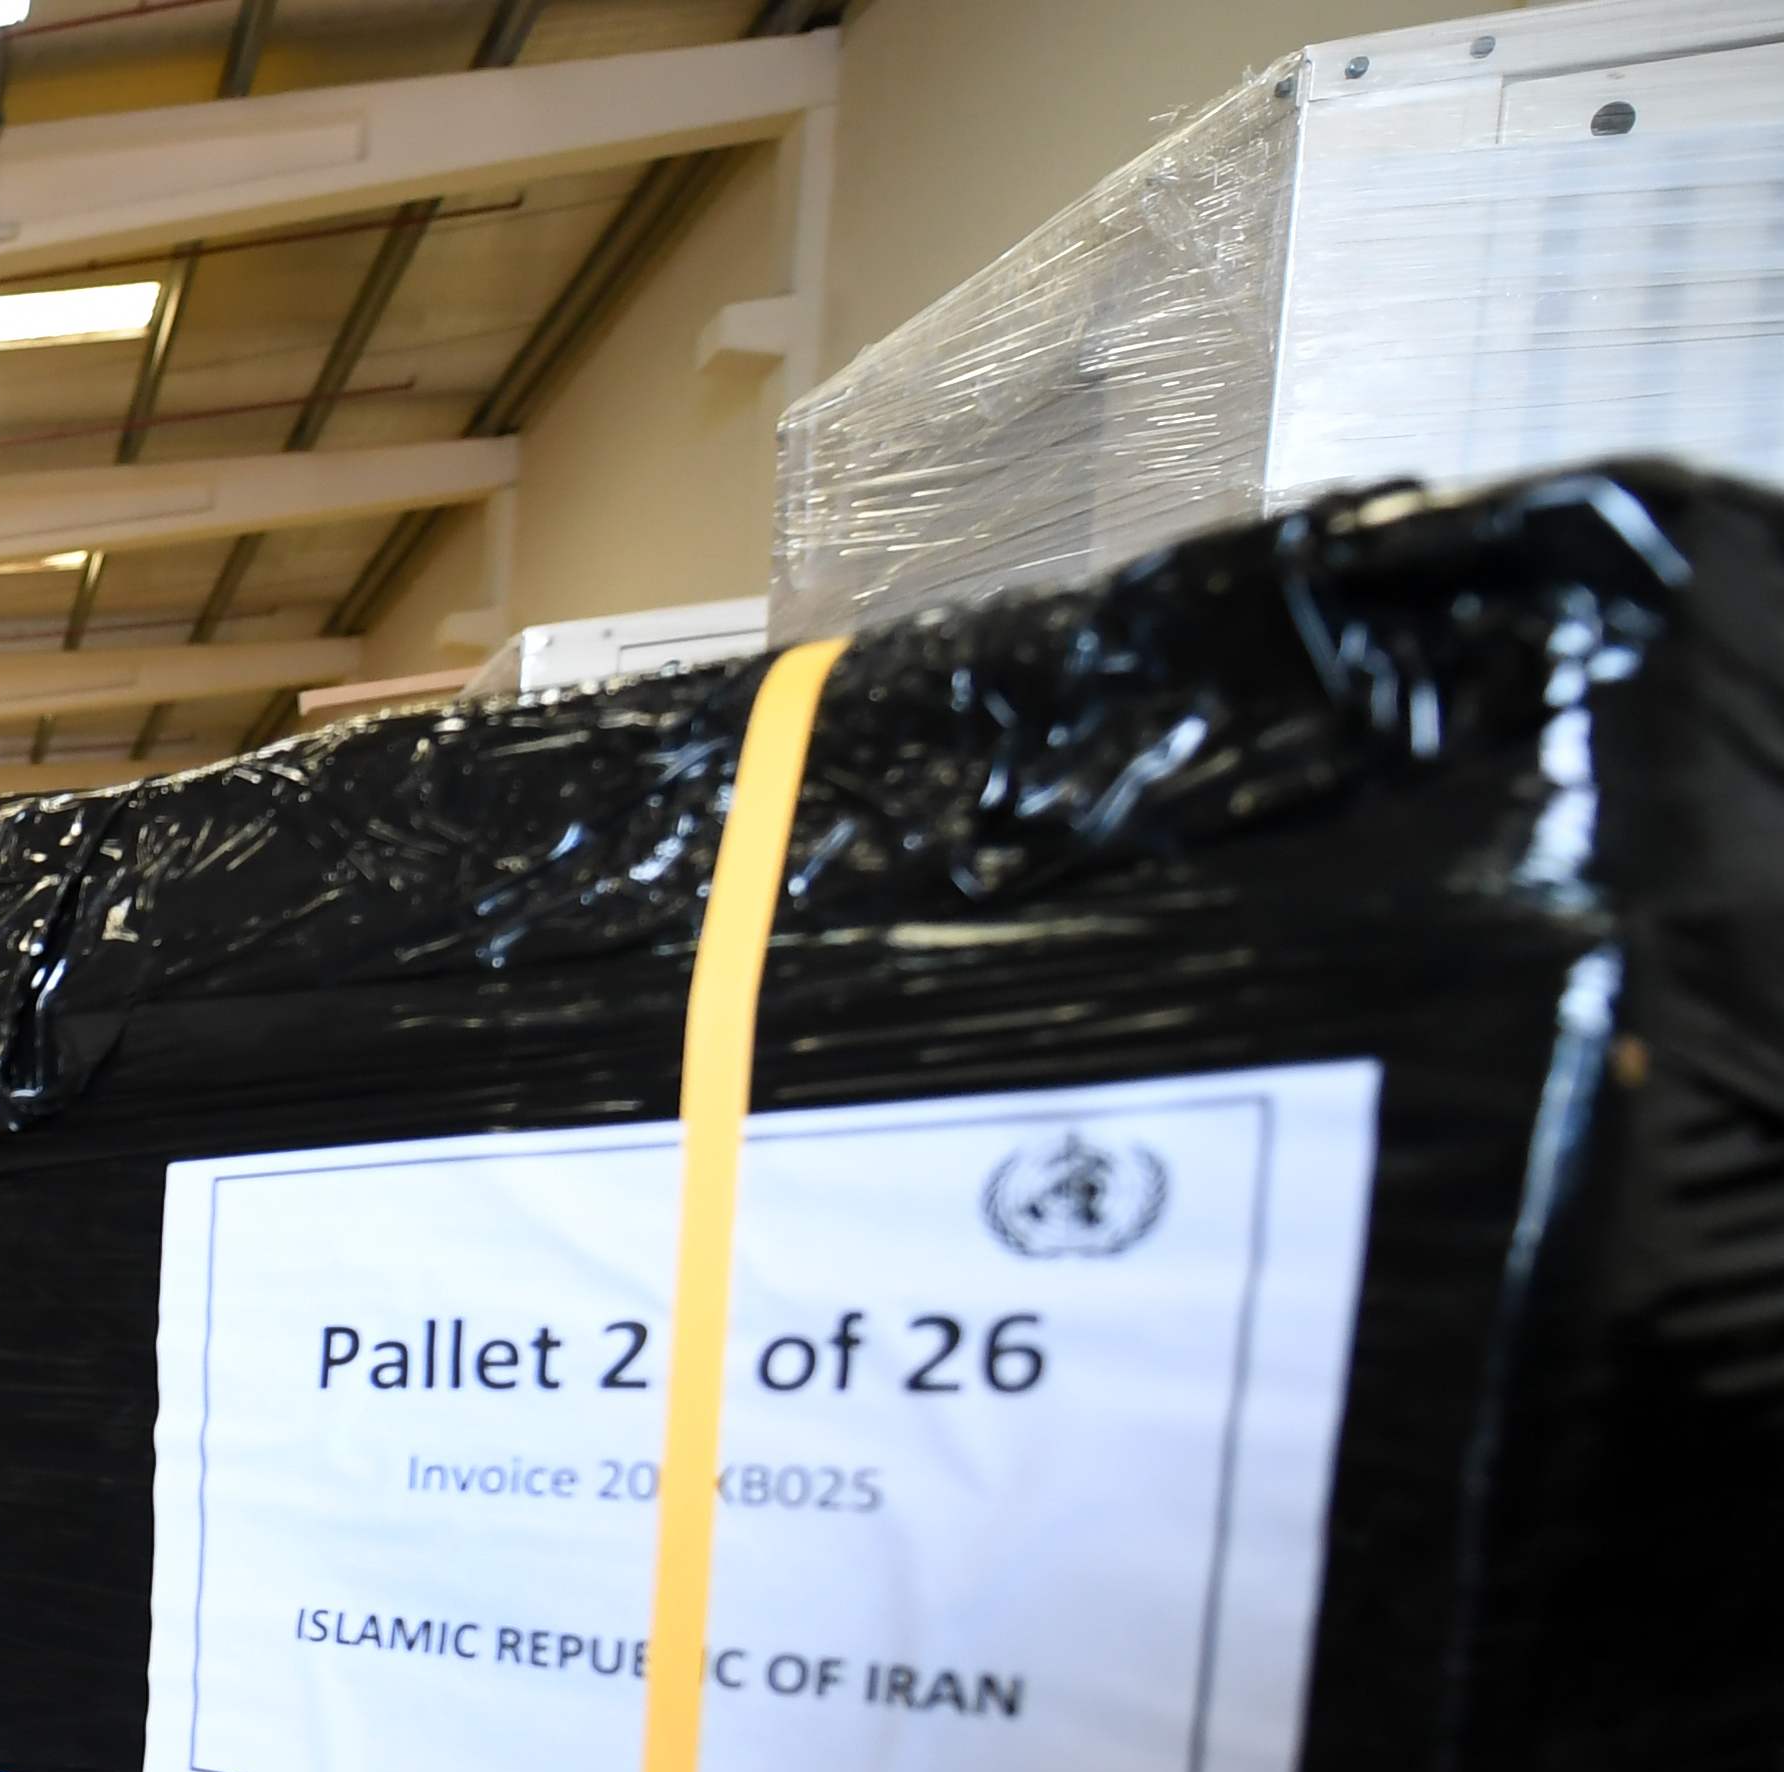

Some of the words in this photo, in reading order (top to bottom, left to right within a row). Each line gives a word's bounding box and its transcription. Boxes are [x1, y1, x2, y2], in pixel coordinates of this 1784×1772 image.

[318, 1317, 564, 1393] Pallet
[757, 1311, 864, 1392] of
[903, 1312, 1047, 1394] 26
[406, 1453, 580, 1501] Invoice
[295, 1605, 480, 1663] ISLAMIC
[766, 1653, 843, 1697] OF
[864, 1662, 1027, 1722] IRAN
